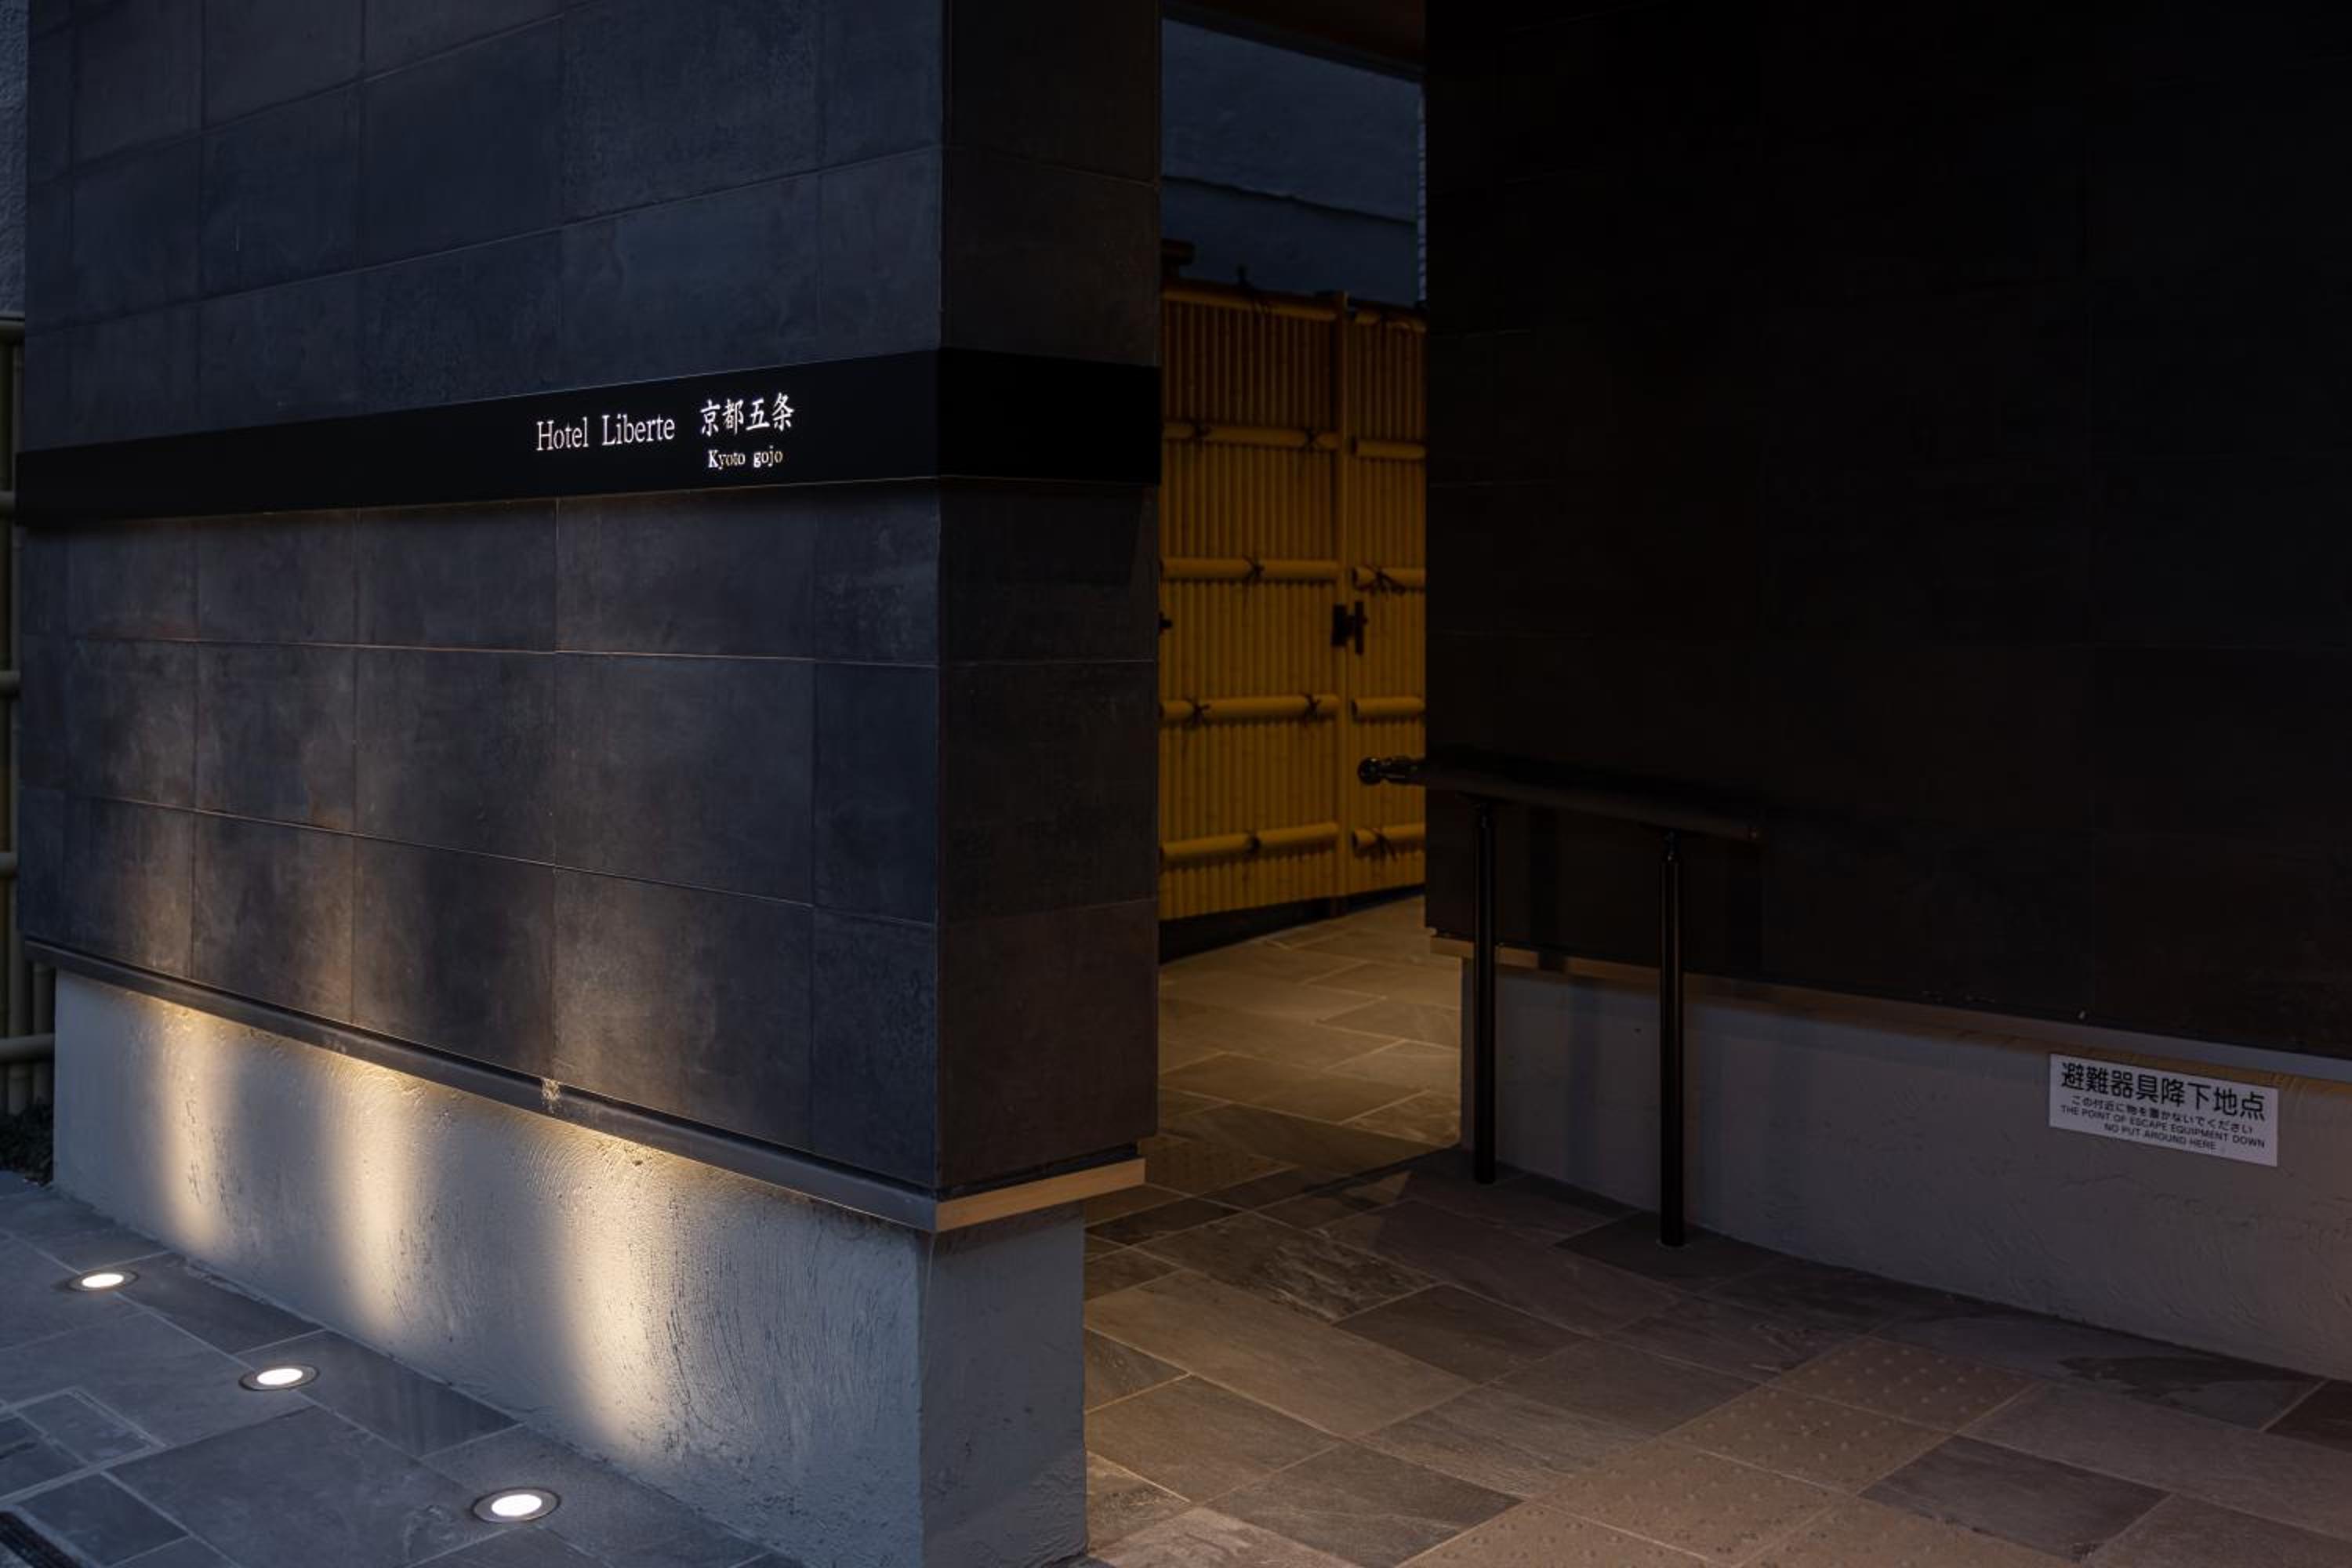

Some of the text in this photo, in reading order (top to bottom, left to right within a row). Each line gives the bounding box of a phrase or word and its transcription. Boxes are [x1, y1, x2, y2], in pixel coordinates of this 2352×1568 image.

[536, 414, 675, 451] Hotel Liberte
[700, 392, 794, 437] 京都五条
[708, 446, 782, 470] Kyoto gojo
[2061, 1062, 2265, 1121] 避難器具降下地点
[2061, 1105, 2265, 1149] THE POINT OF ESCAPE EQUIPMENT DOWN
[2105, 1123, 2216, 1150] NO PUT AROUND HERE
